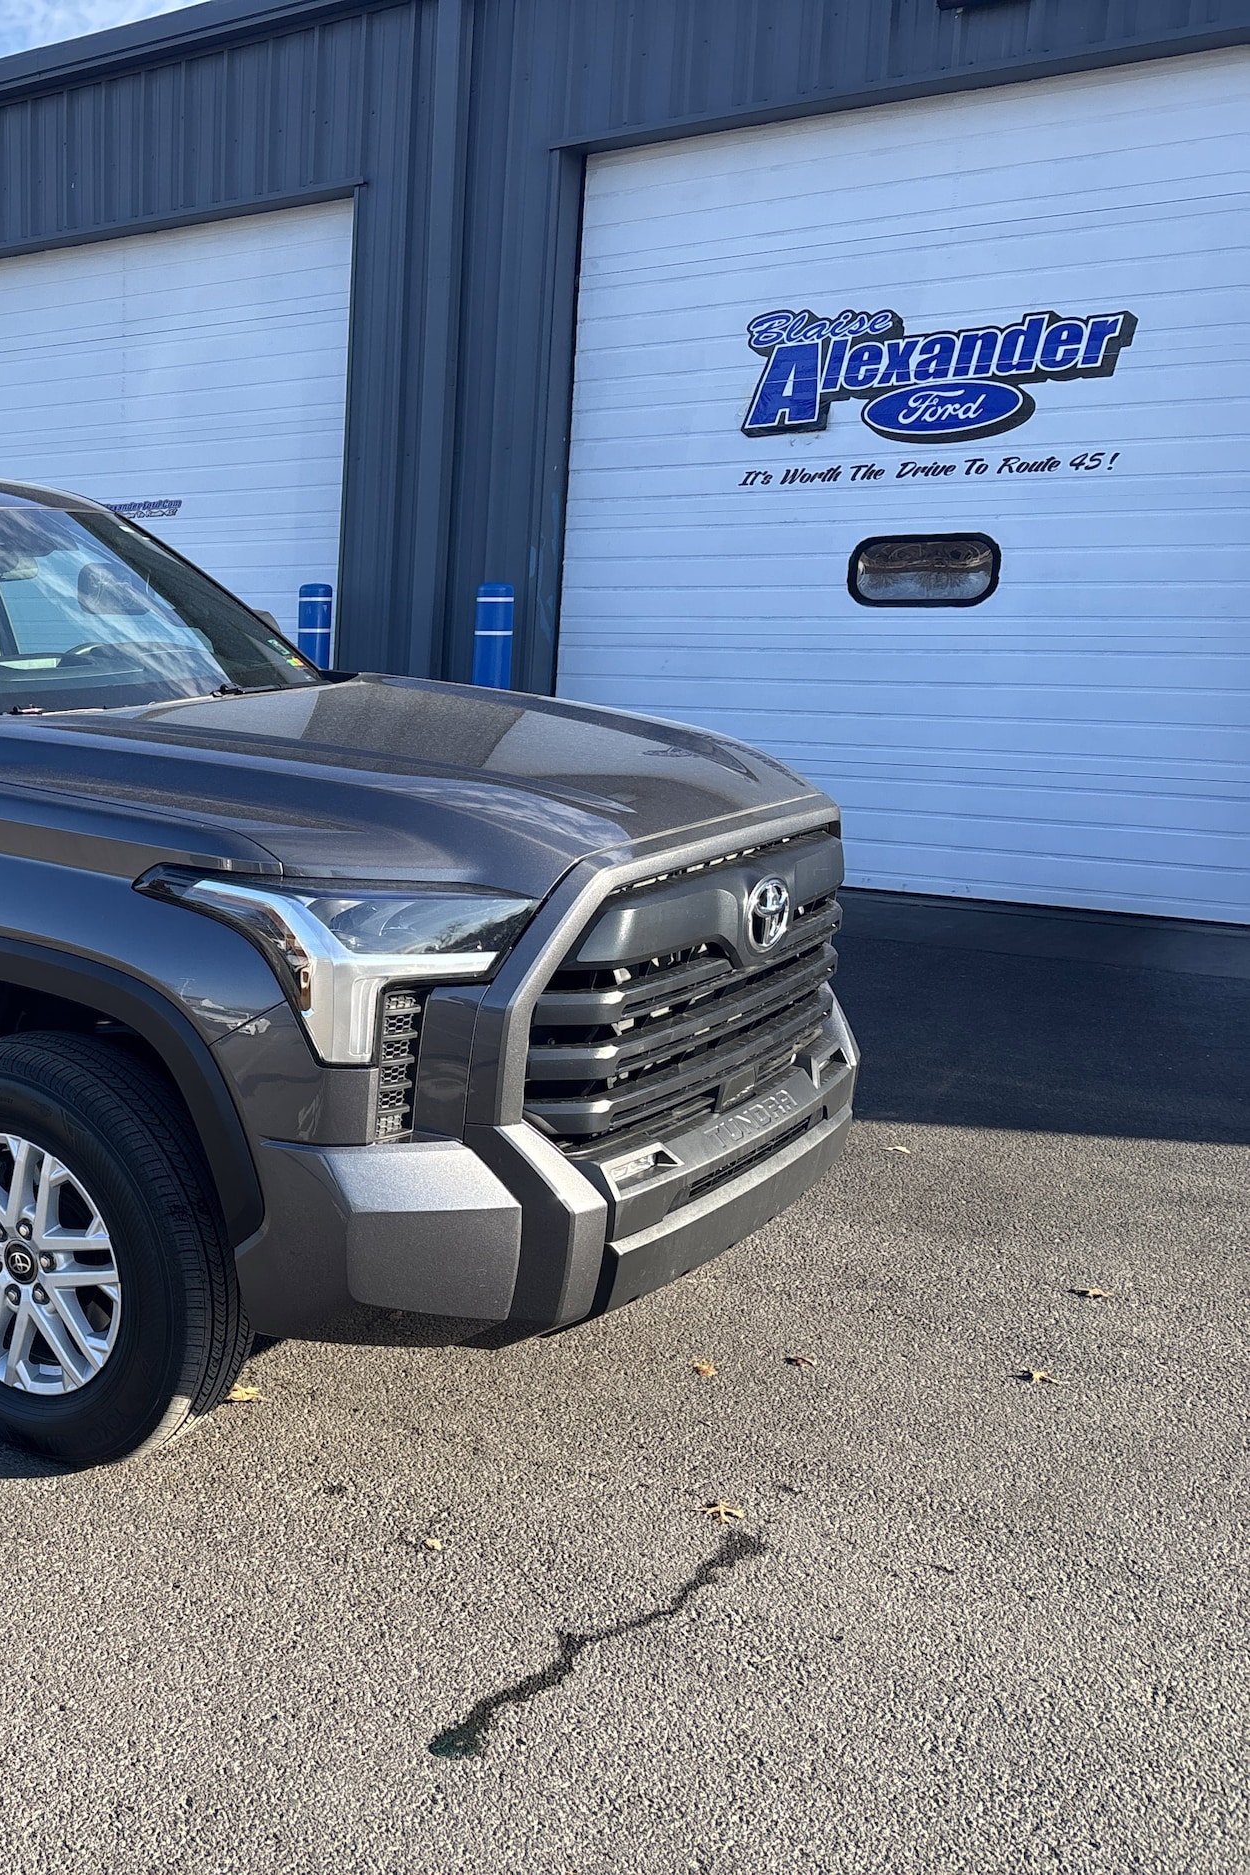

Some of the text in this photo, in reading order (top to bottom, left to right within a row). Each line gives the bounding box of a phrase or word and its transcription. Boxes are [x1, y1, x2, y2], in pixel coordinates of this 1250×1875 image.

[749, 310, 893, 347] Blaise
[744, 312, 1132, 431] Alexander
[897, 388, 985, 425] Ford
[738, 470, 773, 487] It's
[779, 464, 842, 486] Worth
[850, 462, 886, 482] The
[895, 461, 957, 479] Drive
[964, 457, 989, 476] To
[996, 456, 1062, 475] Route
[703, 1089, 798, 1149] TUNDRA
